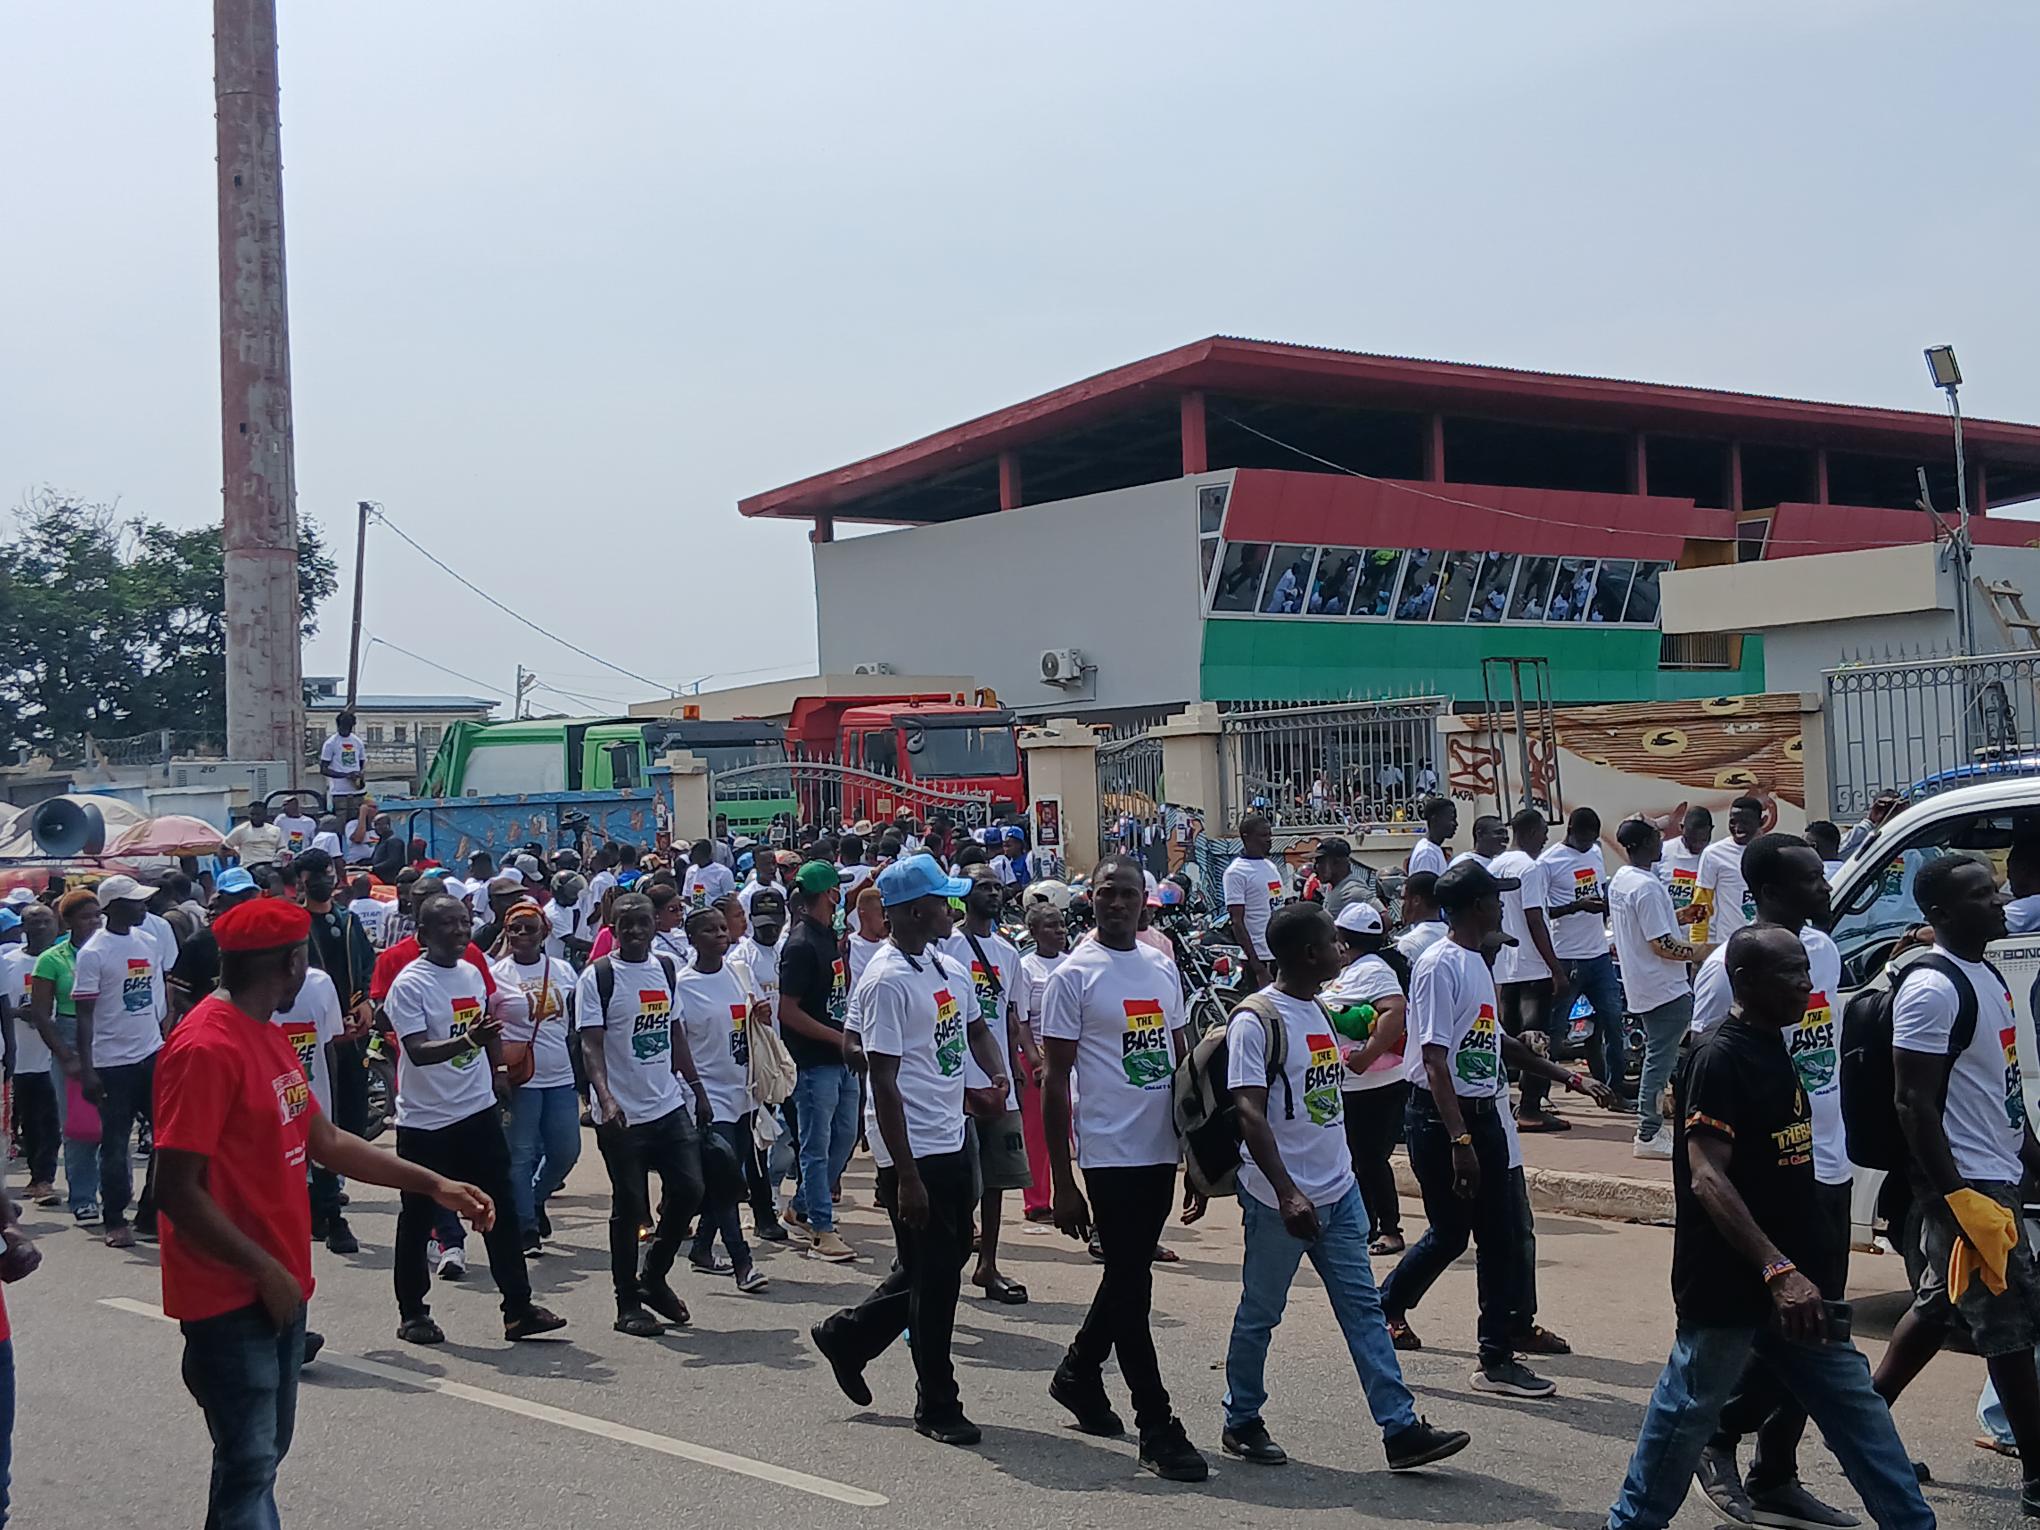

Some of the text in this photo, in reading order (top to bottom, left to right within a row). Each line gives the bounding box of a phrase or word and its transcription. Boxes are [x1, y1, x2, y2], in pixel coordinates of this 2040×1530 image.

[124, 976, 152, 993] BASE
[633, 1013, 670, 1034] BASE
[1136, 1015, 1153, 1027] THE
[1808, 1010, 1823, 1024] THE
[450, 1022, 467, 1038] BA
[934, 1010, 962, 1048] BASE
[1122, 1026, 1167, 1057] BASE
[1790, 1022, 1834, 1057] BASE
[1317, 1050, 1332, 1062] THE
